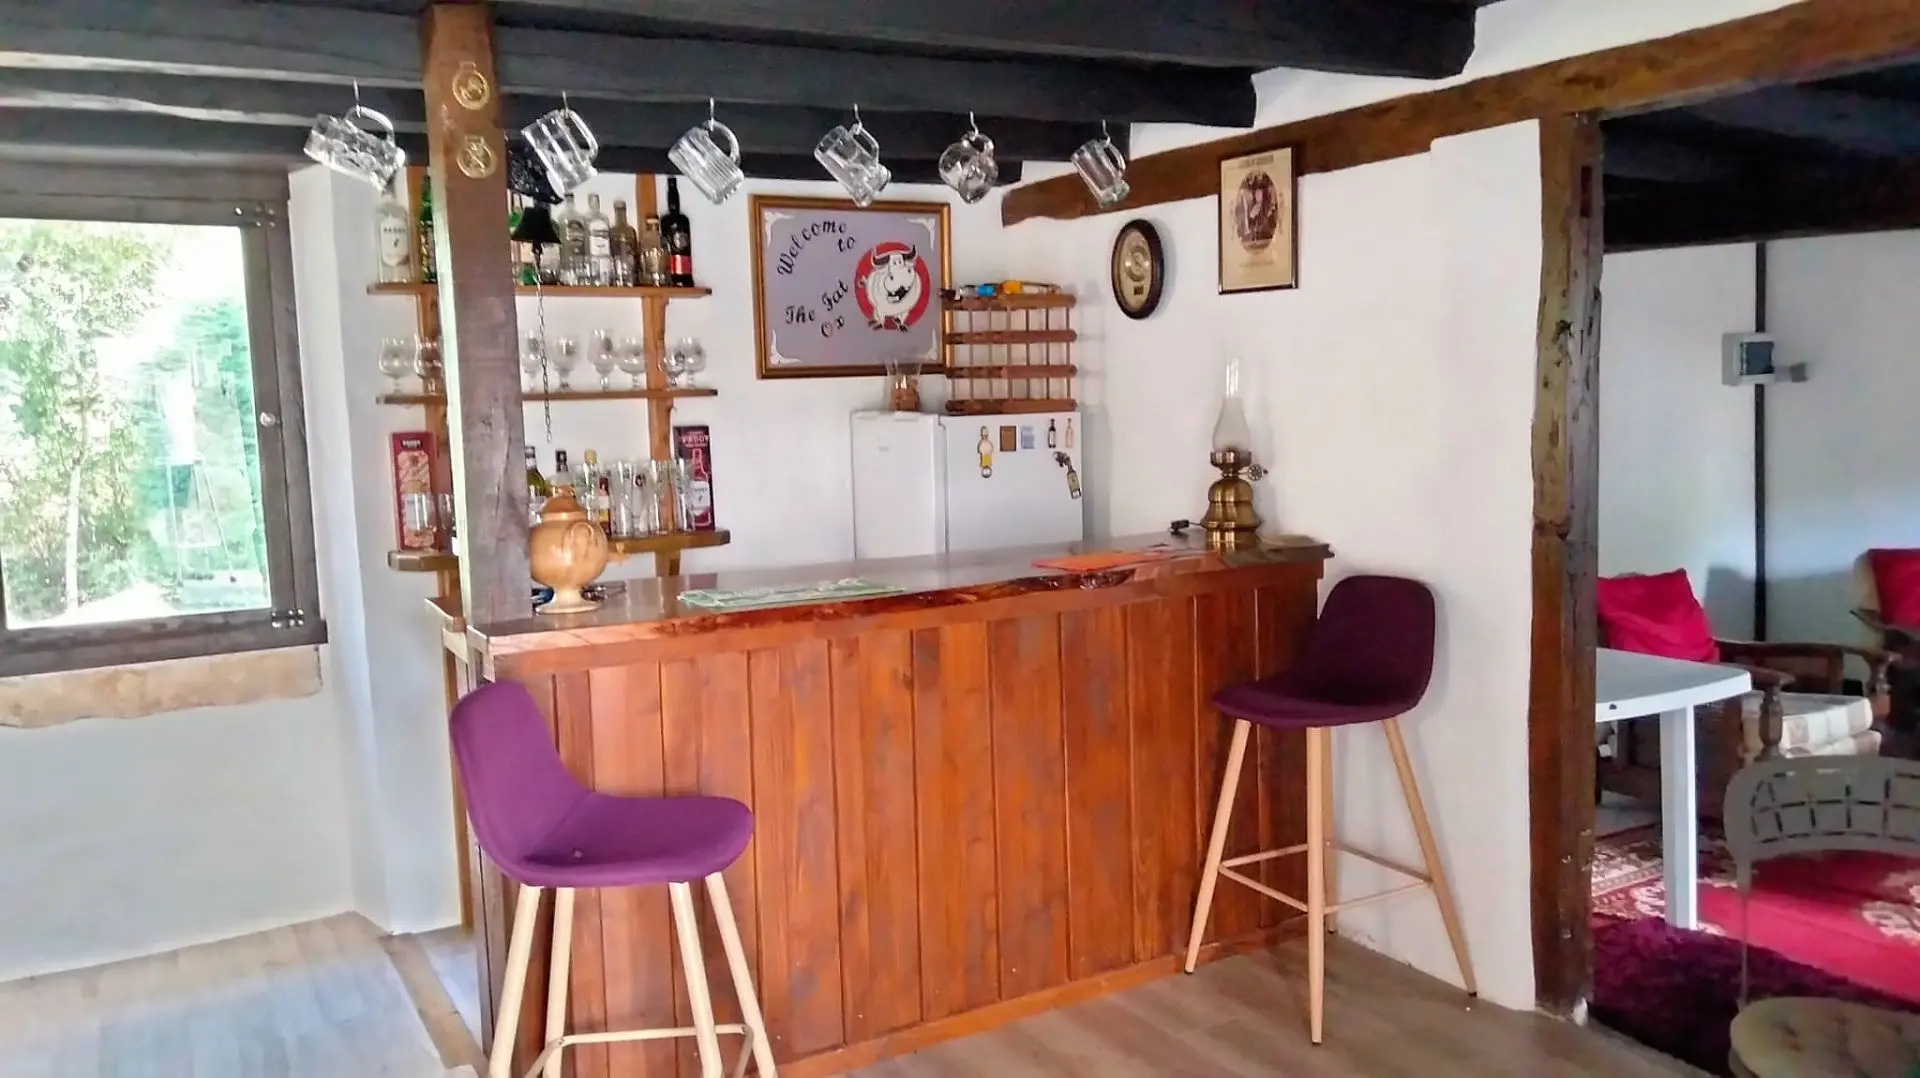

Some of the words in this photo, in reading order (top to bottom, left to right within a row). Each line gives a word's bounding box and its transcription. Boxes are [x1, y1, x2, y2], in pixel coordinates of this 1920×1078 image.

[777, 220, 847, 277] Welcome
[837, 236, 856, 253] to
[785, 304, 816, 325] The
[821, 279, 849, 312] Fat
[820, 315, 846, 338] Ox
